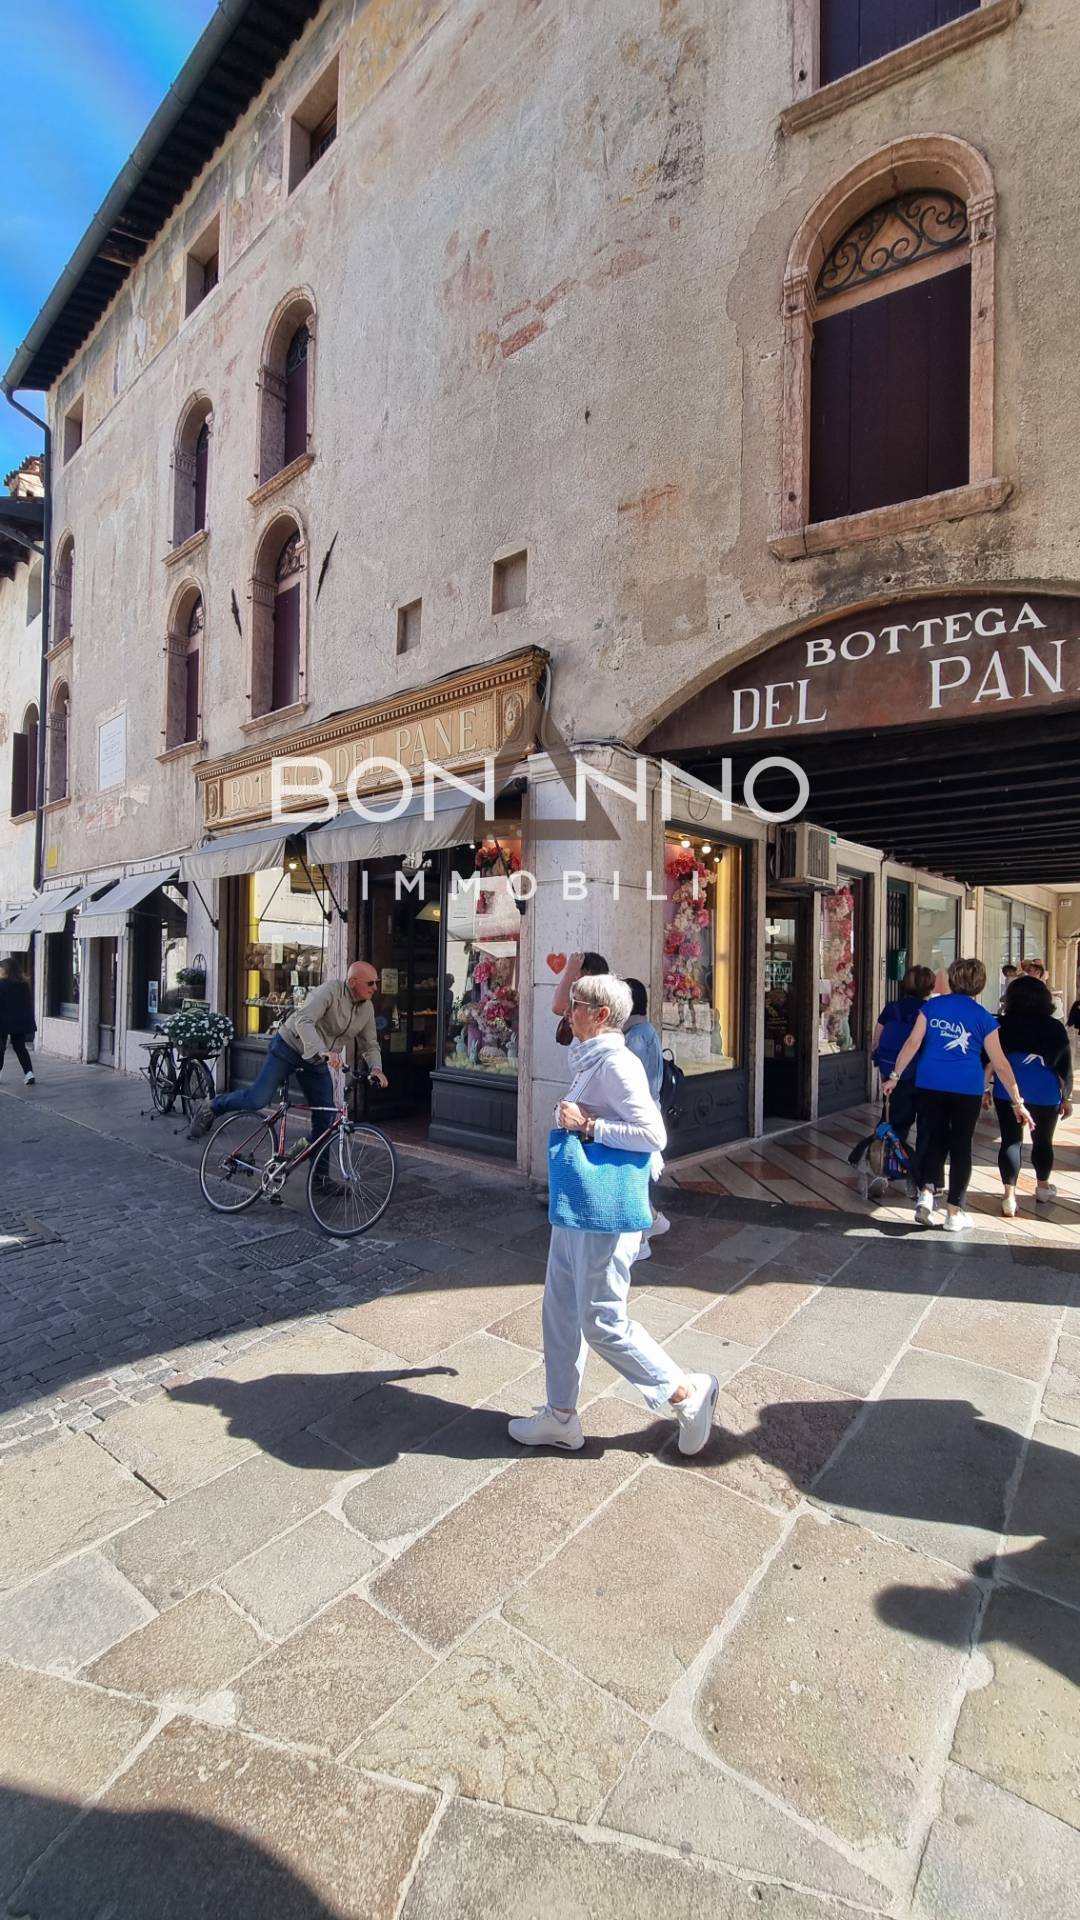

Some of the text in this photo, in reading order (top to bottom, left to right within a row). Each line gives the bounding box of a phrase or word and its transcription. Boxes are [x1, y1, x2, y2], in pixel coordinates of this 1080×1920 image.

[805, 602, 1047, 667] BOTTEGA
[731, 637, 1080, 734] DEL PAN
[231, 708, 477, 810] BOTEGA DEL PANE
